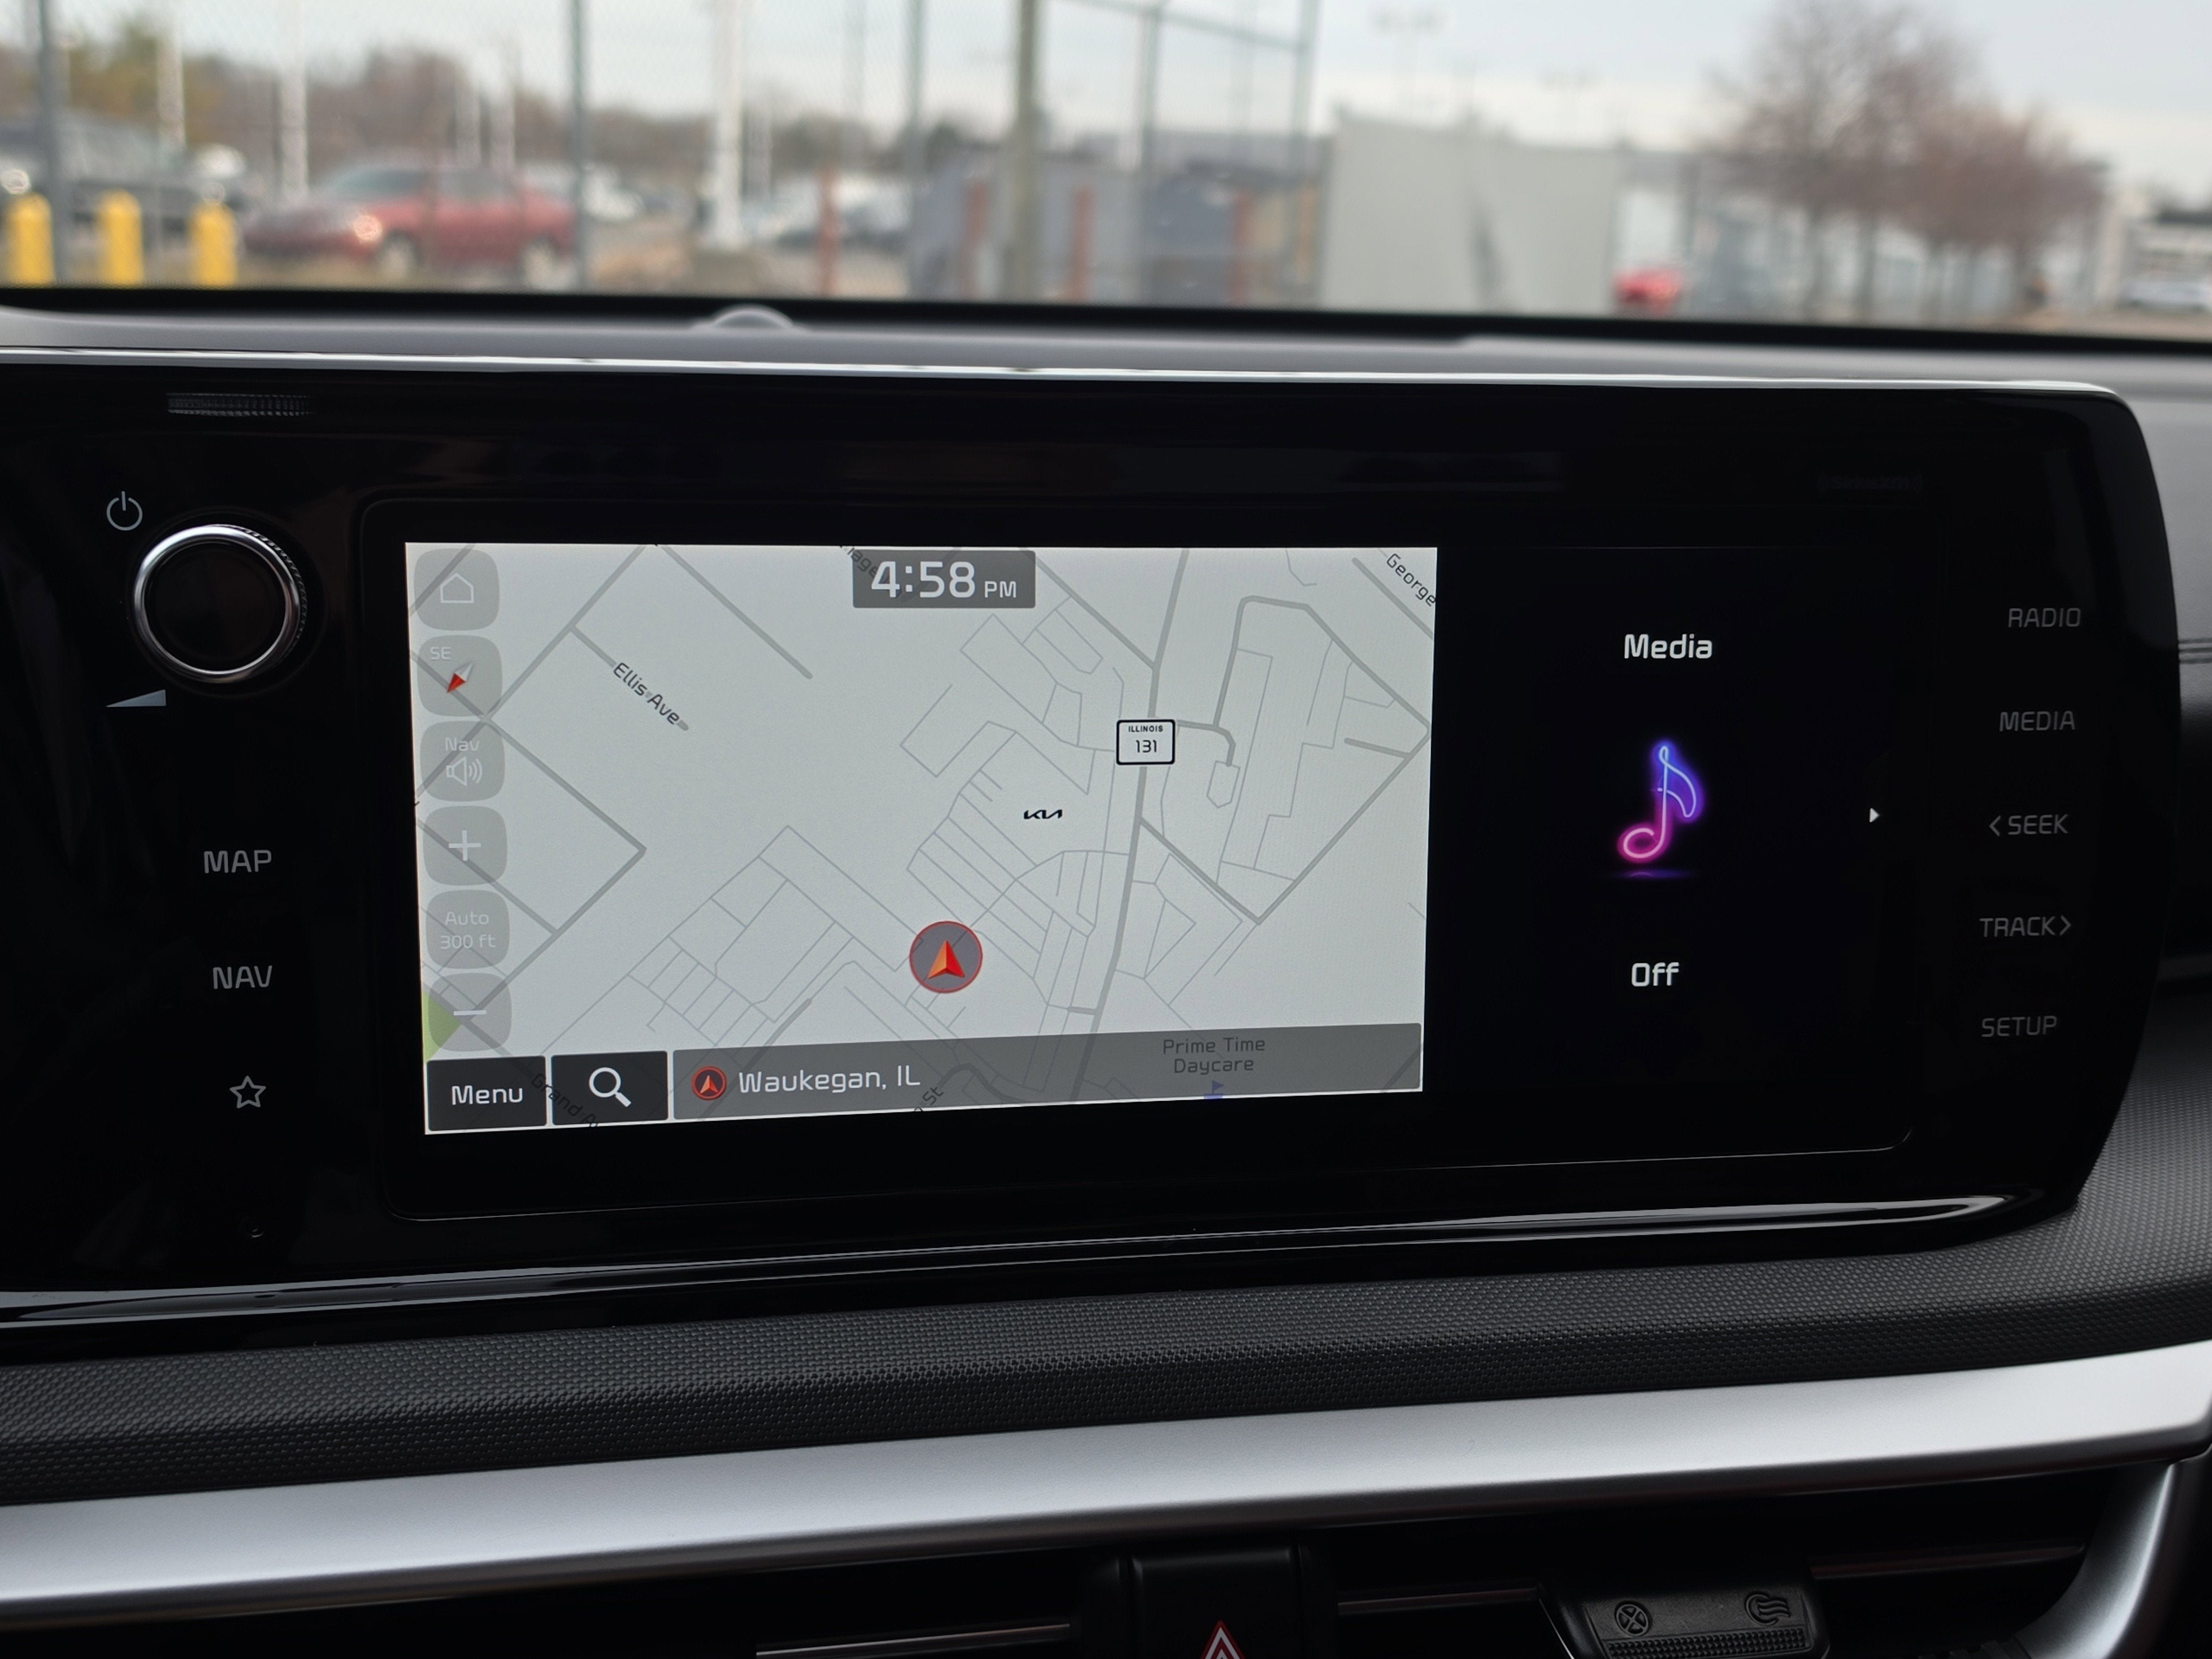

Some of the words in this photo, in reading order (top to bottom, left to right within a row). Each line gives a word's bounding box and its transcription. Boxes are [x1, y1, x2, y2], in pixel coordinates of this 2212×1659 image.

[871, 561, 975, 598] 4:58
[985, 581, 1017, 598] PM
[1387, 554, 1436, 607] George
[2008, 607, 2081, 628] RADIO
[430, 647, 452, 660] SE
[1624, 634, 1713, 659] Media
[614, 662, 648, 696] Ellis
[647, 693, 680, 725] Ave
[1999, 711, 2075, 732] MEDIA
[445, 737, 480, 751] Nav
[1136, 740, 1157, 753] 131
[204, 850, 272, 873] MAP
[445, 911, 490, 926] Auto
[440, 935, 473, 950] 300
[479, 934, 496, 949] ft
[213, 965, 272, 989] NAV
[1631, 962, 1679, 987] Off
[1981, 1015, 2057, 1037] SETUP
[1163, 1038, 1216, 1054] Prime
[1223, 1037, 1265, 1052] Time
[1174, 1058, 1254, 1075] Daycare
[739, 1070, 886, 1094] Waukegan,
[898, 1065, 921, 1086] IL
[452, 1085, 523, 1105] Menu
[531, 1073, 584, 1116] Grand
[922, 1086, 944, 1105] St
